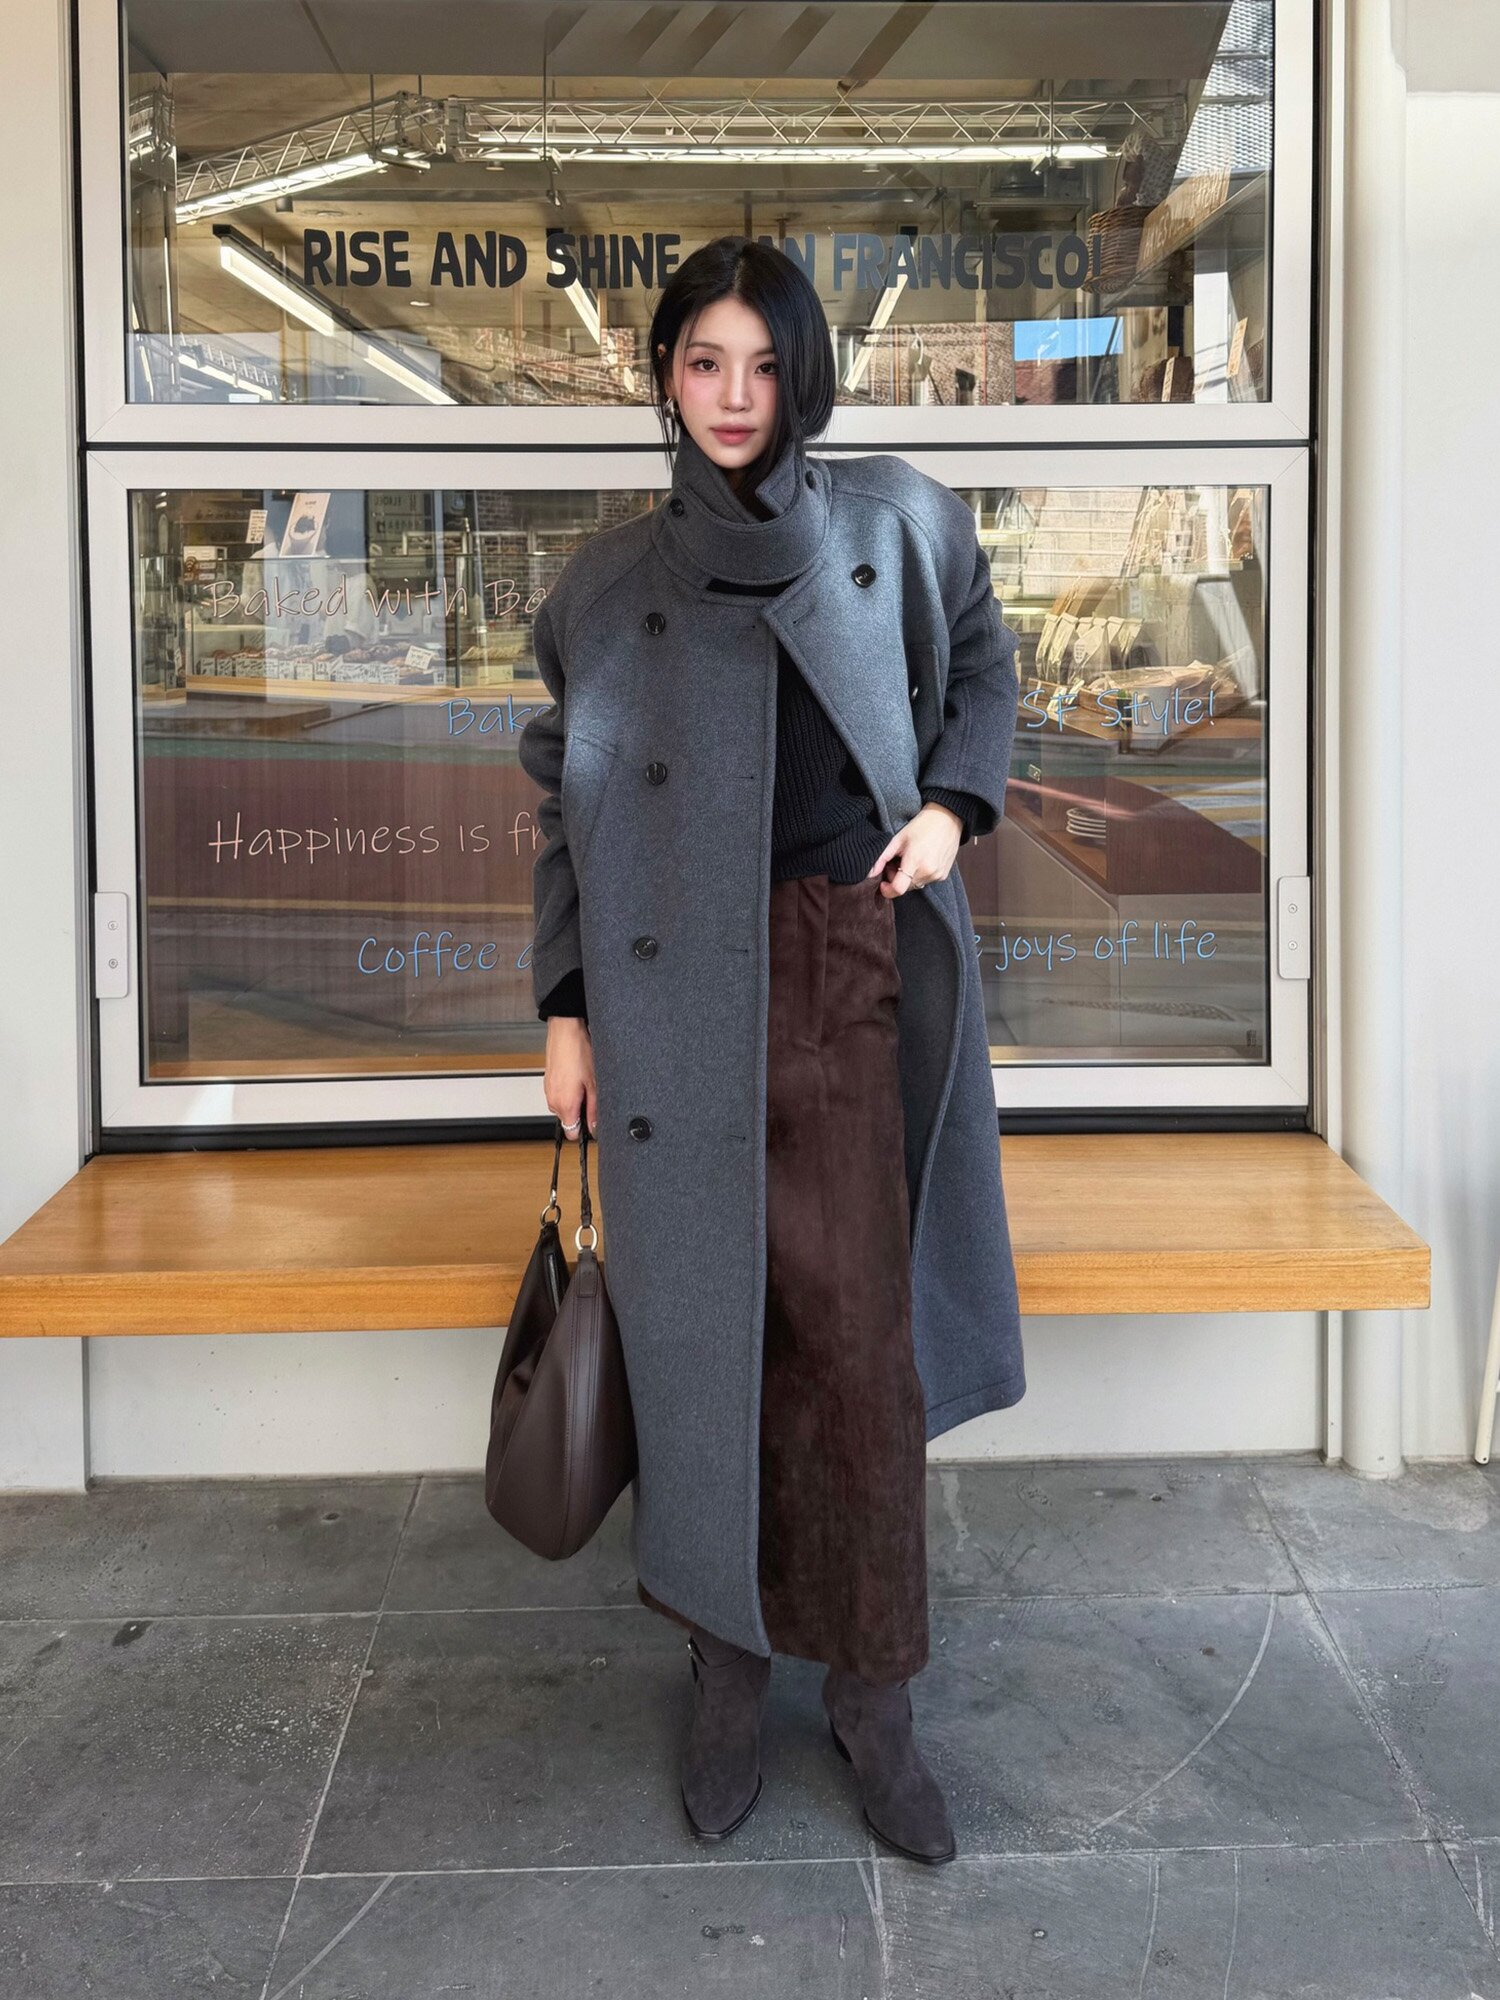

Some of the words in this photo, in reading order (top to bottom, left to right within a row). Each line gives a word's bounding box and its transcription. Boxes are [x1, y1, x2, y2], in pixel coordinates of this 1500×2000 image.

[303, 228, 412, 287] RISE
[431, 230, 527, 288] AND
[546, 232, 681, 289] SHINE
[203, 573, 349, 618] Baked
[365, 577, 469, 617] with
[440, 693, 551, 736] Bak
[1023, 689, 1078, 732] SF
[1096, 687, 1215, 736] Style!
[208, 812, 440, 864] Happiness
[357, 931, 500, 977] Coffee
[995, 921, 1077, 972] joys
[1094, 920, 1138, 965] of
[1153, 920, 1217, 965] life
